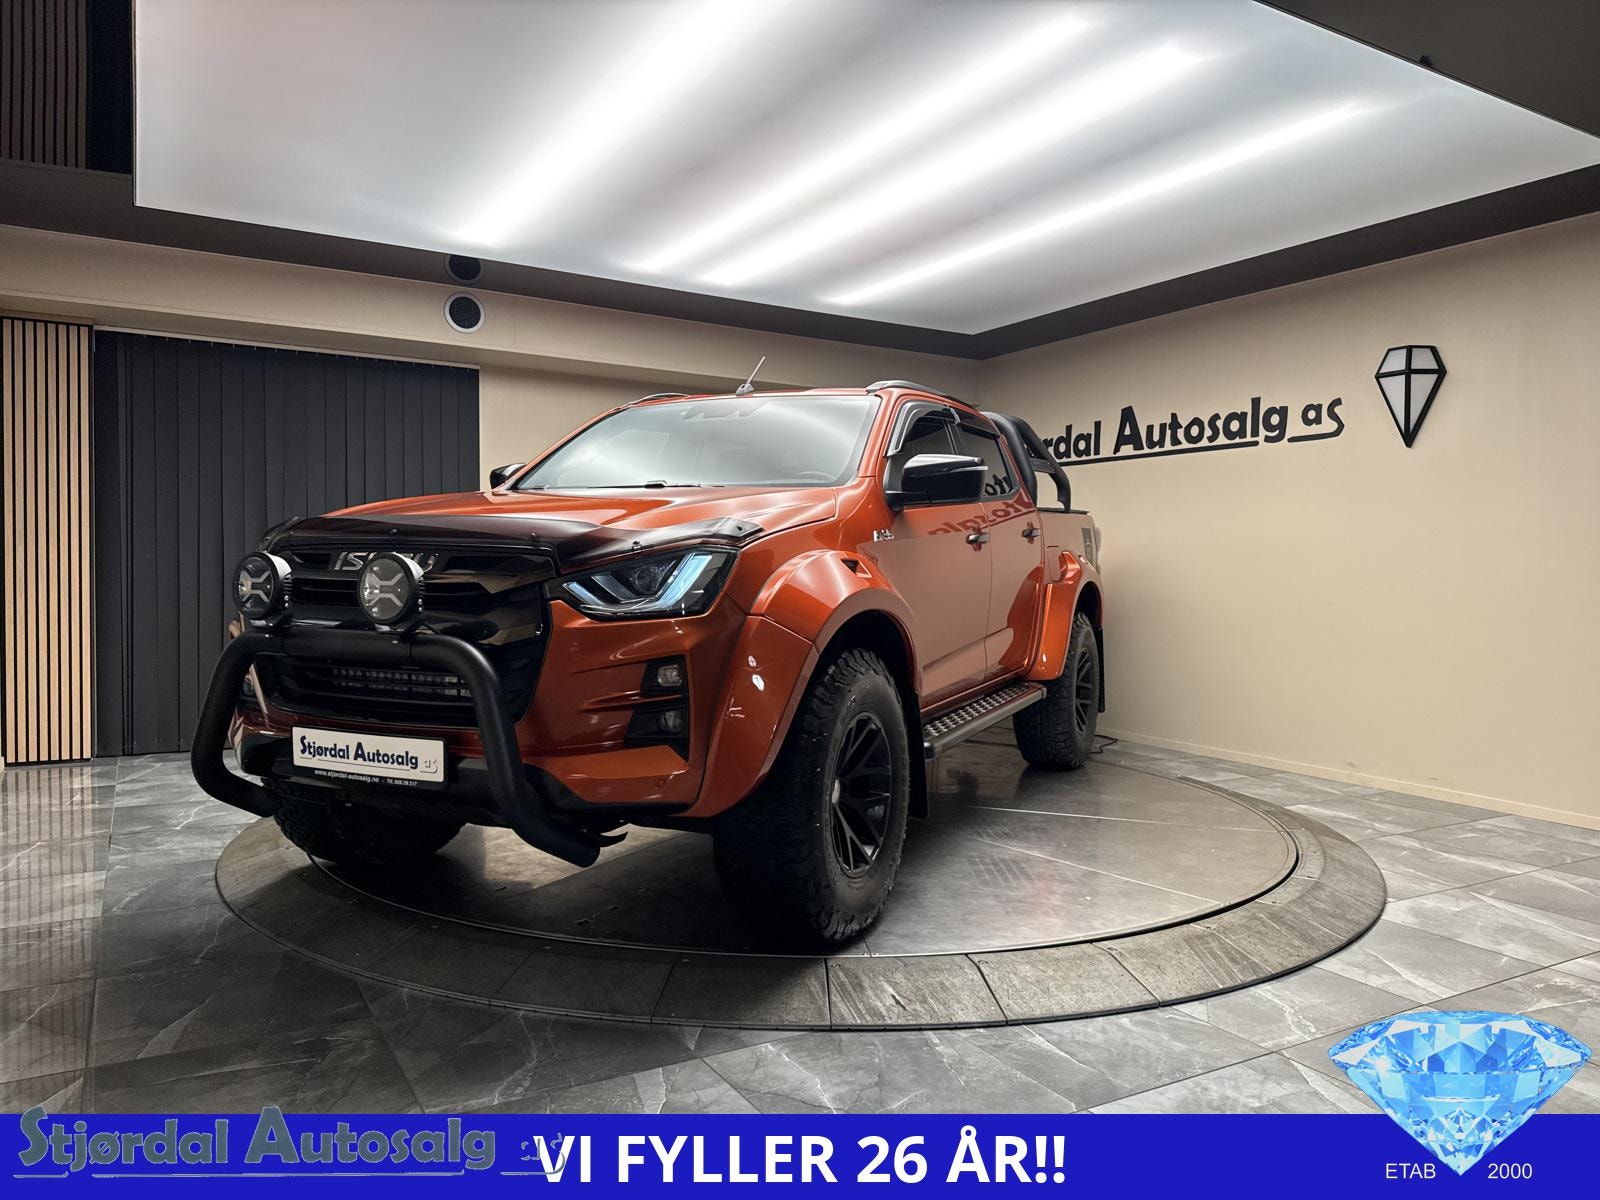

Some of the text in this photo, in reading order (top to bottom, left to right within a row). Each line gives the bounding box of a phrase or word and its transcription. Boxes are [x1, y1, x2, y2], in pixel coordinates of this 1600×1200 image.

[1040, 396, 1345, 460] rdal Autosalg as
[334, 551, 440, 573] ISU
[299, 735, 350, 760] Stjørdal
[353, 741, 418, 770] Autosalg
